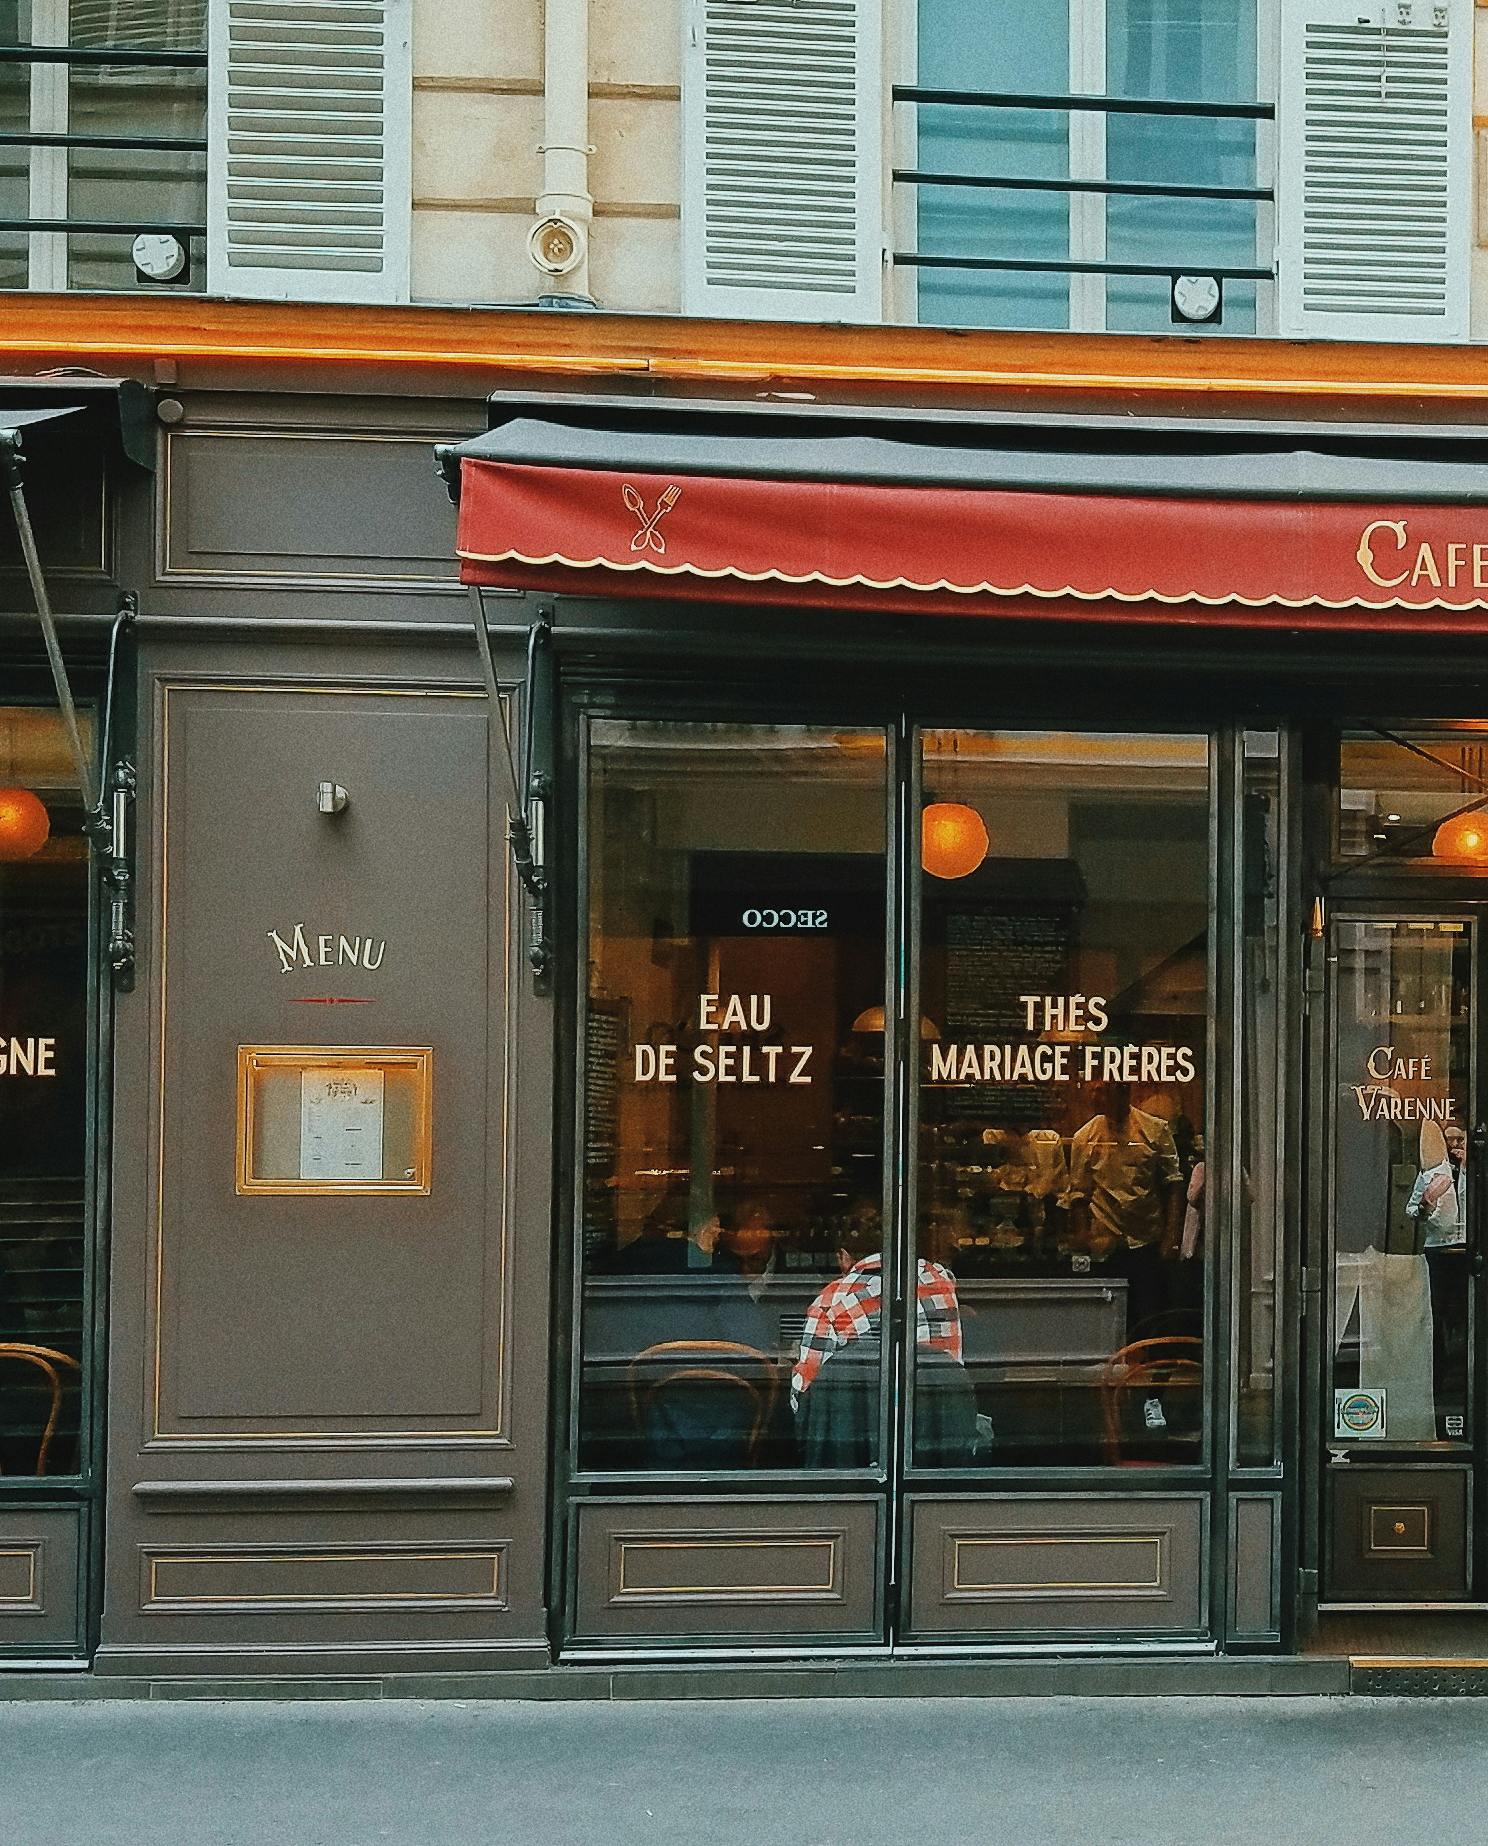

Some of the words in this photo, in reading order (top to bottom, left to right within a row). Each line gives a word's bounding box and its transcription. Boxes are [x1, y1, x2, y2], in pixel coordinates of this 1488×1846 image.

[267, 923, 385, 973] MENU
[699, 994, 771, 1031] EAU
[1019, 993, 1109, 1032] THÉS
[634, 1044, 677, 1082] DE
[692, 1044, 813, 1083] SELTZ
[931, 1043, 1070, 1081] MARIAGE
[1367, 1046, 1432, 1080] CAFÉ
[1350, 1086, 1456, 1121] VARENNE
